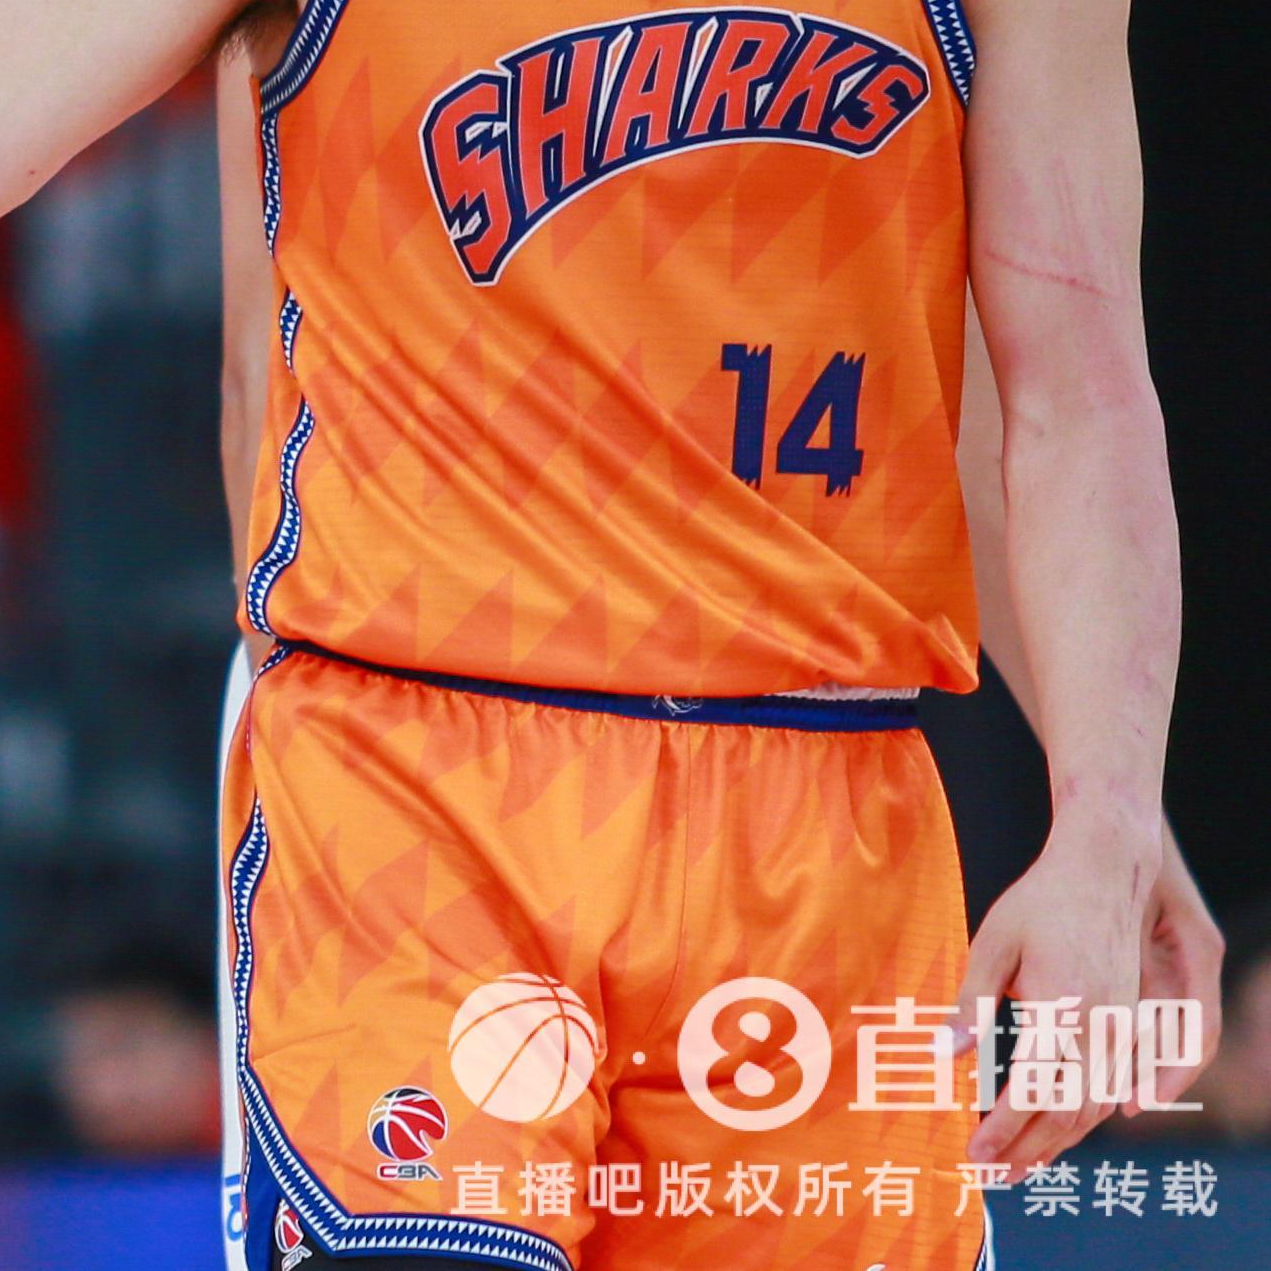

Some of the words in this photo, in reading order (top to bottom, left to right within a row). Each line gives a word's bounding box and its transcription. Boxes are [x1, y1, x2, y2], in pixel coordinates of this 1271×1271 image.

[419, 5, 931, 287] SHARKS
[721, 343, 866, 498] 14
[377, 1162, 441, 1180] CBA
